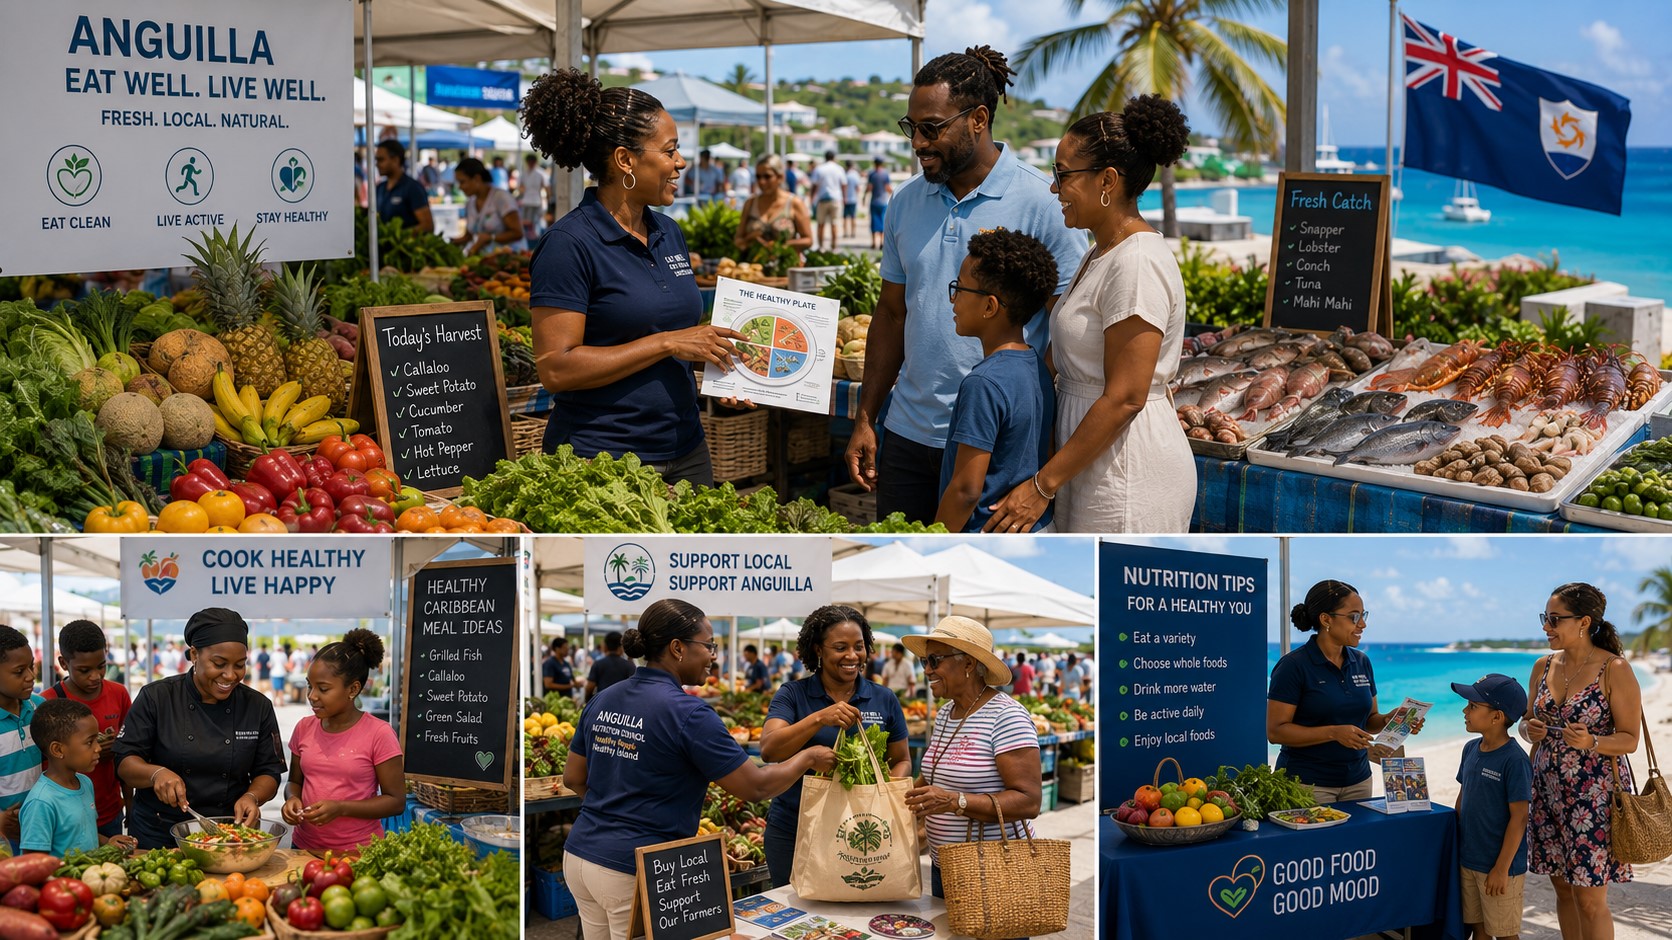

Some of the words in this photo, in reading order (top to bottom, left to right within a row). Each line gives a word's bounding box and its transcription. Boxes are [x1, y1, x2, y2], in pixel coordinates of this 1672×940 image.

[68, 15, 274, 66] ANGUILLA
[65, 67, 116, 94] EAT
[124, 71, 200, 98] WELL.
[208, 75, 257, 100] LIVE
[263, 78, 326, 102] WELL.
[101, 109, 158, 128] FRESH.
[163, 111, 217, 128] LOCAL.
[221, 112, 290, 129] NATURAL.
[1291, 190, 1327, 208] Fresh
[1332, 192, 1372, 210] Catch
[41, 216, 66, 231] EAT
[70, 215, 111, 230] CLEAN
[156, 214, 182, 228] LIVE
[184, 213, 224, 227] ACTIVE
[256, 212, 282, 224] STAY
[284, 210, 328, 224] HEALTHY
[1300, 221, 1344, 238] Snapper
[1298, 240, 1341, 254] Lobster
[1296, 258, 1330, 272] Conch
[1295, 276, 1321, 290] Tuna
[739, 288, 754, 299] THE
[756, 292, 792, 306] HEALTHY
[792, 299, 816, 310] PLATE
[1293, 295, 1320, 308] Mahi
[1324, 296, 1352, 310] Mahi
[382, 326, 431, 352] Today's
[435, 324, 482, 344] Harvest
[403, 360, 450, 377] Callaloo
[406, 383, 440, 398] Sweet
[443, 379, 476, 393] Potato
[409, 401, 464, 418] Cucumber
[411, 422, 452, 438] Tomato
[414, 444, 434, 459] Hot
[438, 442, 474, 459] Pepper
[417, 464, 460, 480] Lettuce
[202, 548, 264, 568] COOK
[271, 548, 366, 568] HEALTHY
[669, 552, 740, 569] SUPPORT
[744, 554, 792, 570] LOCAL
[211, 576, 256, 594] LIVE
[264, 576, 336, 595] HAPPY
[427, 578, 488, 595] HEALTHY
[669, 575, 738, 591] SUPPORT
[741, 576, 813, 592] ANGUILLA
[1123, 566, 1218, 591] NUTRITION
[1222, 574, 1255, 593] TIPS
[424, 598, 495, 615] CARIBBEAN
[1127, 596, 1154, 612] FOR
[1158, 598, 1168, 612] A
[1171, 598, 1226, 614] HEALTHY
[1228, 601, 1252, 615] YOU
[422, 619, 456, 636] MEAL
[462, 619, 503, 634] IDEAS
[1133, 631, 1150, 644] Eat
[1154, 634, 1160, 644] a
[1163, 632, 1196, 646] variety
[429, 648, 460, 662] Grilled
[464, 648, 482, 662] Fish
[1133, 657, 1170, 670] Choose
[1173, 656, 1200, 668] whole
[1203, 656, 1228, 668] foods
[428, 669, 465, 683] Callaloo
[426, 690, 455, 704] Sweet
[458, 690, 488, 704] Potato
[1134, 683, 1161, 695] Drink
[1164, 685, 1188, 694] more
[1190, 682, 1216, 693] water
[426, 710, 452, 724] Green
[456, 711, 482, 724] Salad
[596, 710, 642, 730] ANGUILLA
[1134, 708, 1148, 721] Be
[1150, 707, 1180, 720] active
[1182, 705, 1204, 719] daily
[424, 730, 448, 744] Fresh
[452, 731, 478, 745] Fruits
[1134, 734, 1162, 748] Enjoy
[1164, 730, 1187, 744] local
[1190, 728, 1216, 742] foods
[653, 858, 676, 876] Buy
[680, 849, 708, 869] Local
[1273, 856, 1324, 886] GOOD
[1330, 848, 1376, 876] FOOD
[656, 877, 676, 894] Eat
[681, 870, 710, 886] Fresh
[658, 890, 701, 914] Support
[1273, 886, 1324, 916] GOOD
[1330, 875, 1379, 905] MOOD
[659, 914, 680, 930] Our
[683, 904, 722, 924] Farmers
